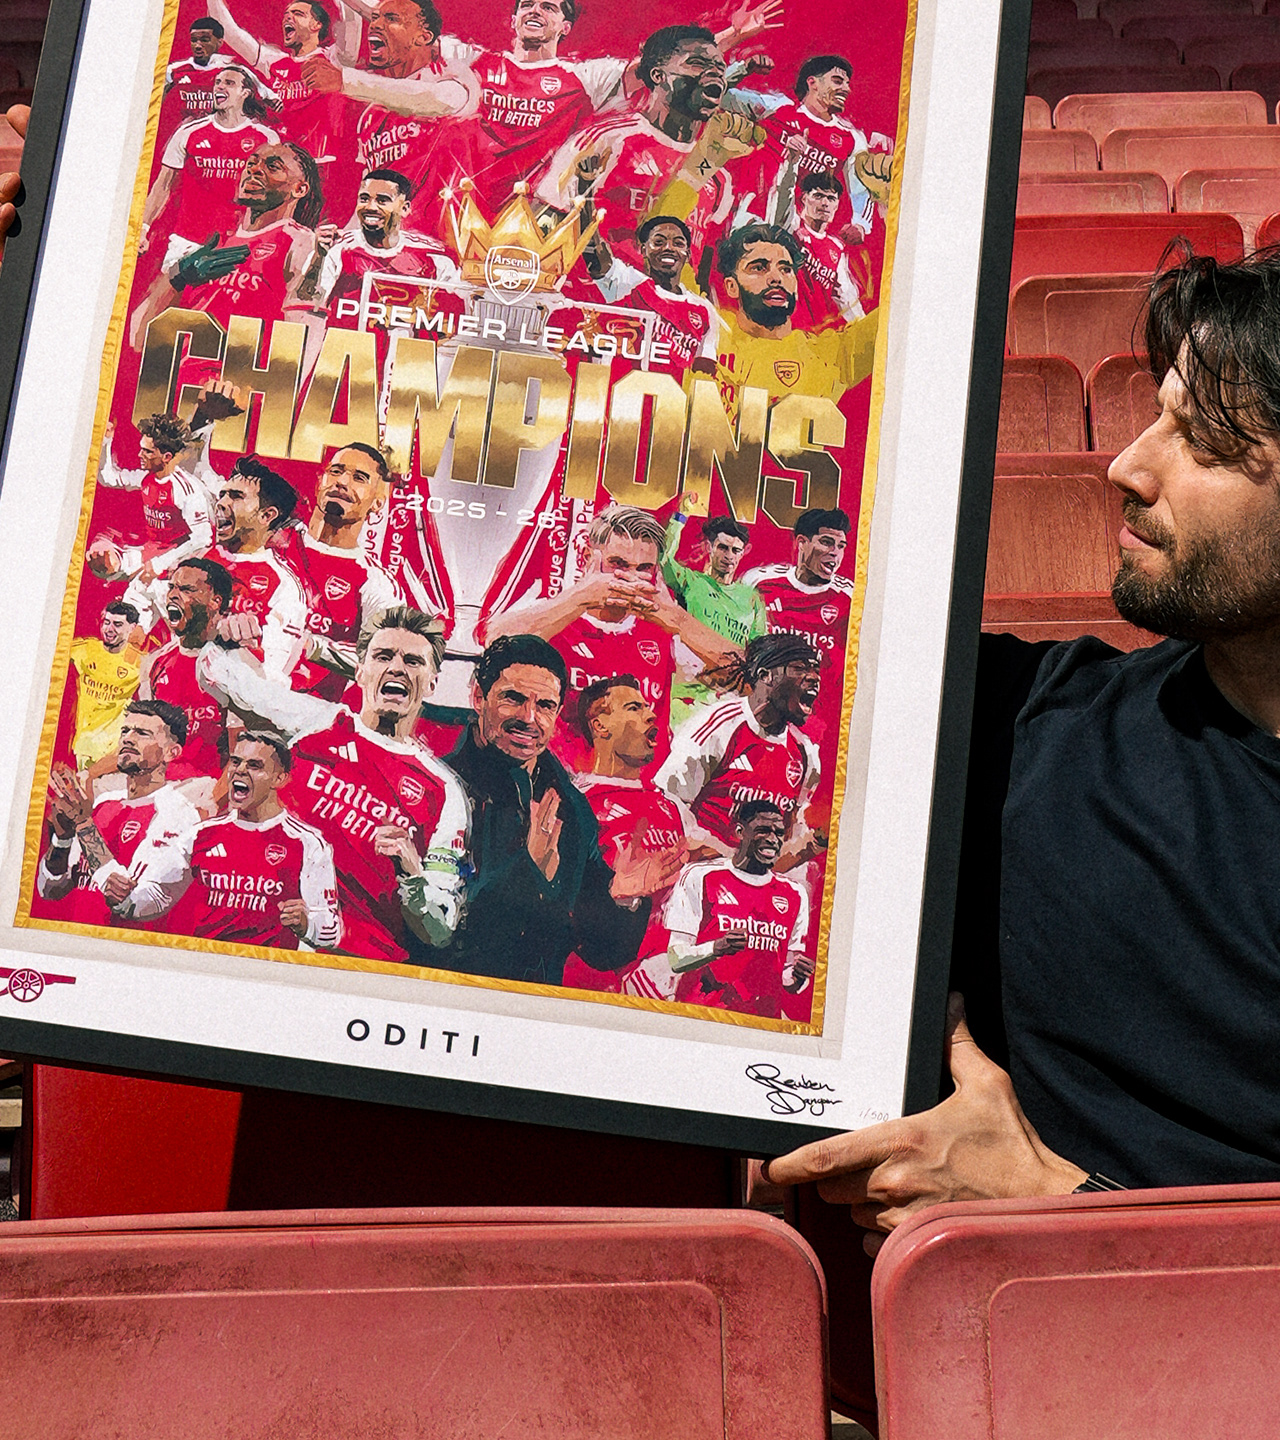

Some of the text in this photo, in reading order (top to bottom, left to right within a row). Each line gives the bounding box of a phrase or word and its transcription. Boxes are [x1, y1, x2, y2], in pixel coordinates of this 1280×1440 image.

[483, 88, 556, 114] Emirates
[504, 110, 542, 128] BETTER
[493, 254, 533, 268] Arsenal
[336, 298, 671, 365] PREMIER LEAGUE
[131, 307, 848, 531] CHAMPIONS
[405, 493, 486, 520] 2025
[312, 797, 345, 821] FLY
[200, 869, 285, 896] Emirates
[717, 913, 788, 940] Emirates
[747, 935, 780, 952] BETTER
[346, 1018, 480, 1057] ODITI
